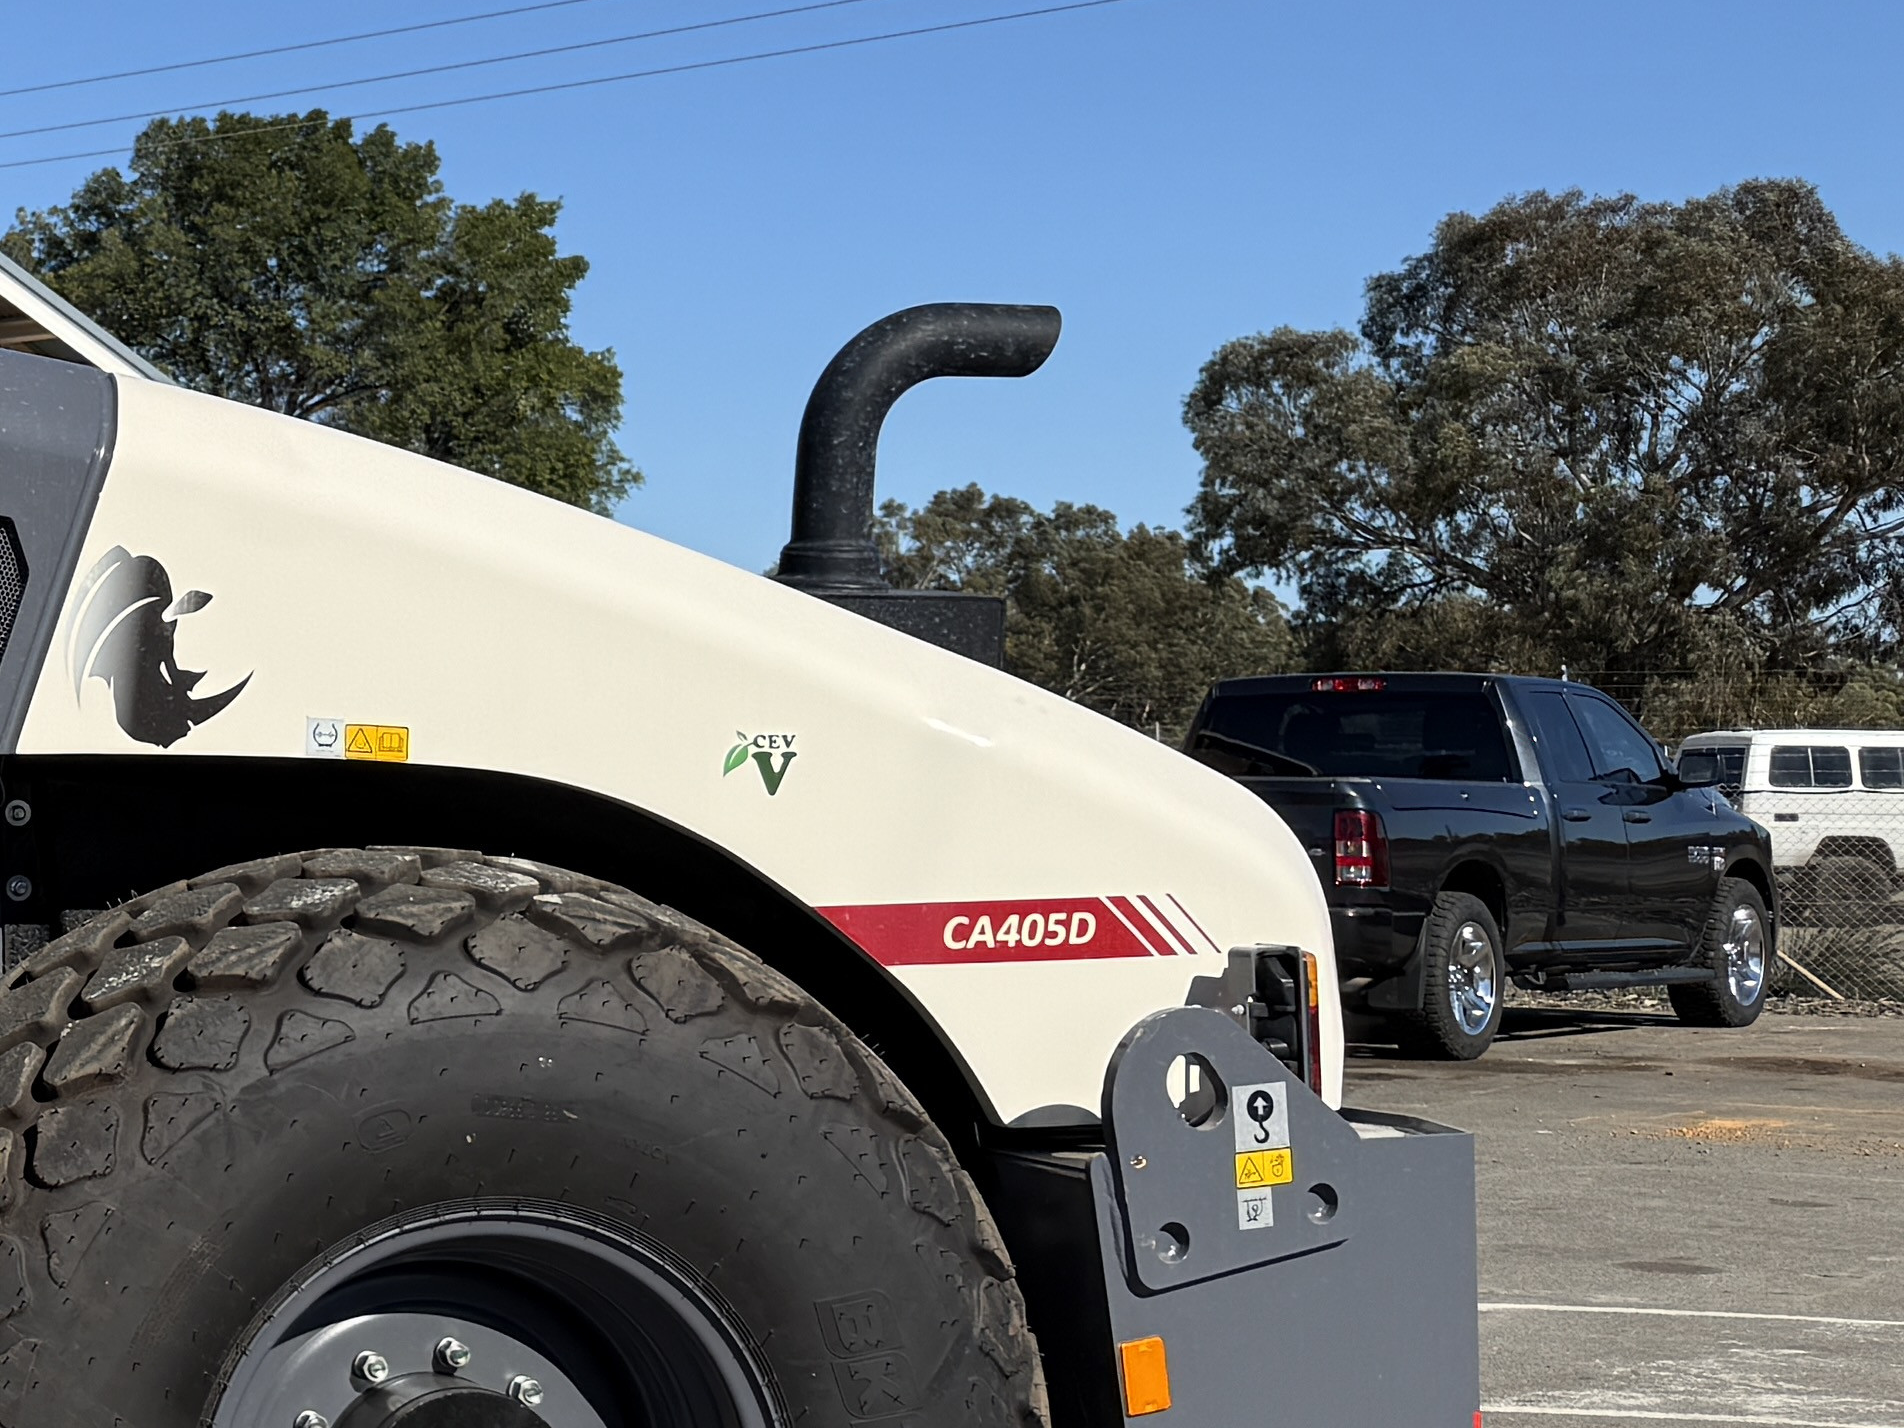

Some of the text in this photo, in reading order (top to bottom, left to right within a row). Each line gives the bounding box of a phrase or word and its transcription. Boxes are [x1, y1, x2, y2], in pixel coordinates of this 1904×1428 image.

[753, 734, 796, 749] CEV
[751, 751, 798, 797] V
[943, 911, 1097, 950] CA405D
